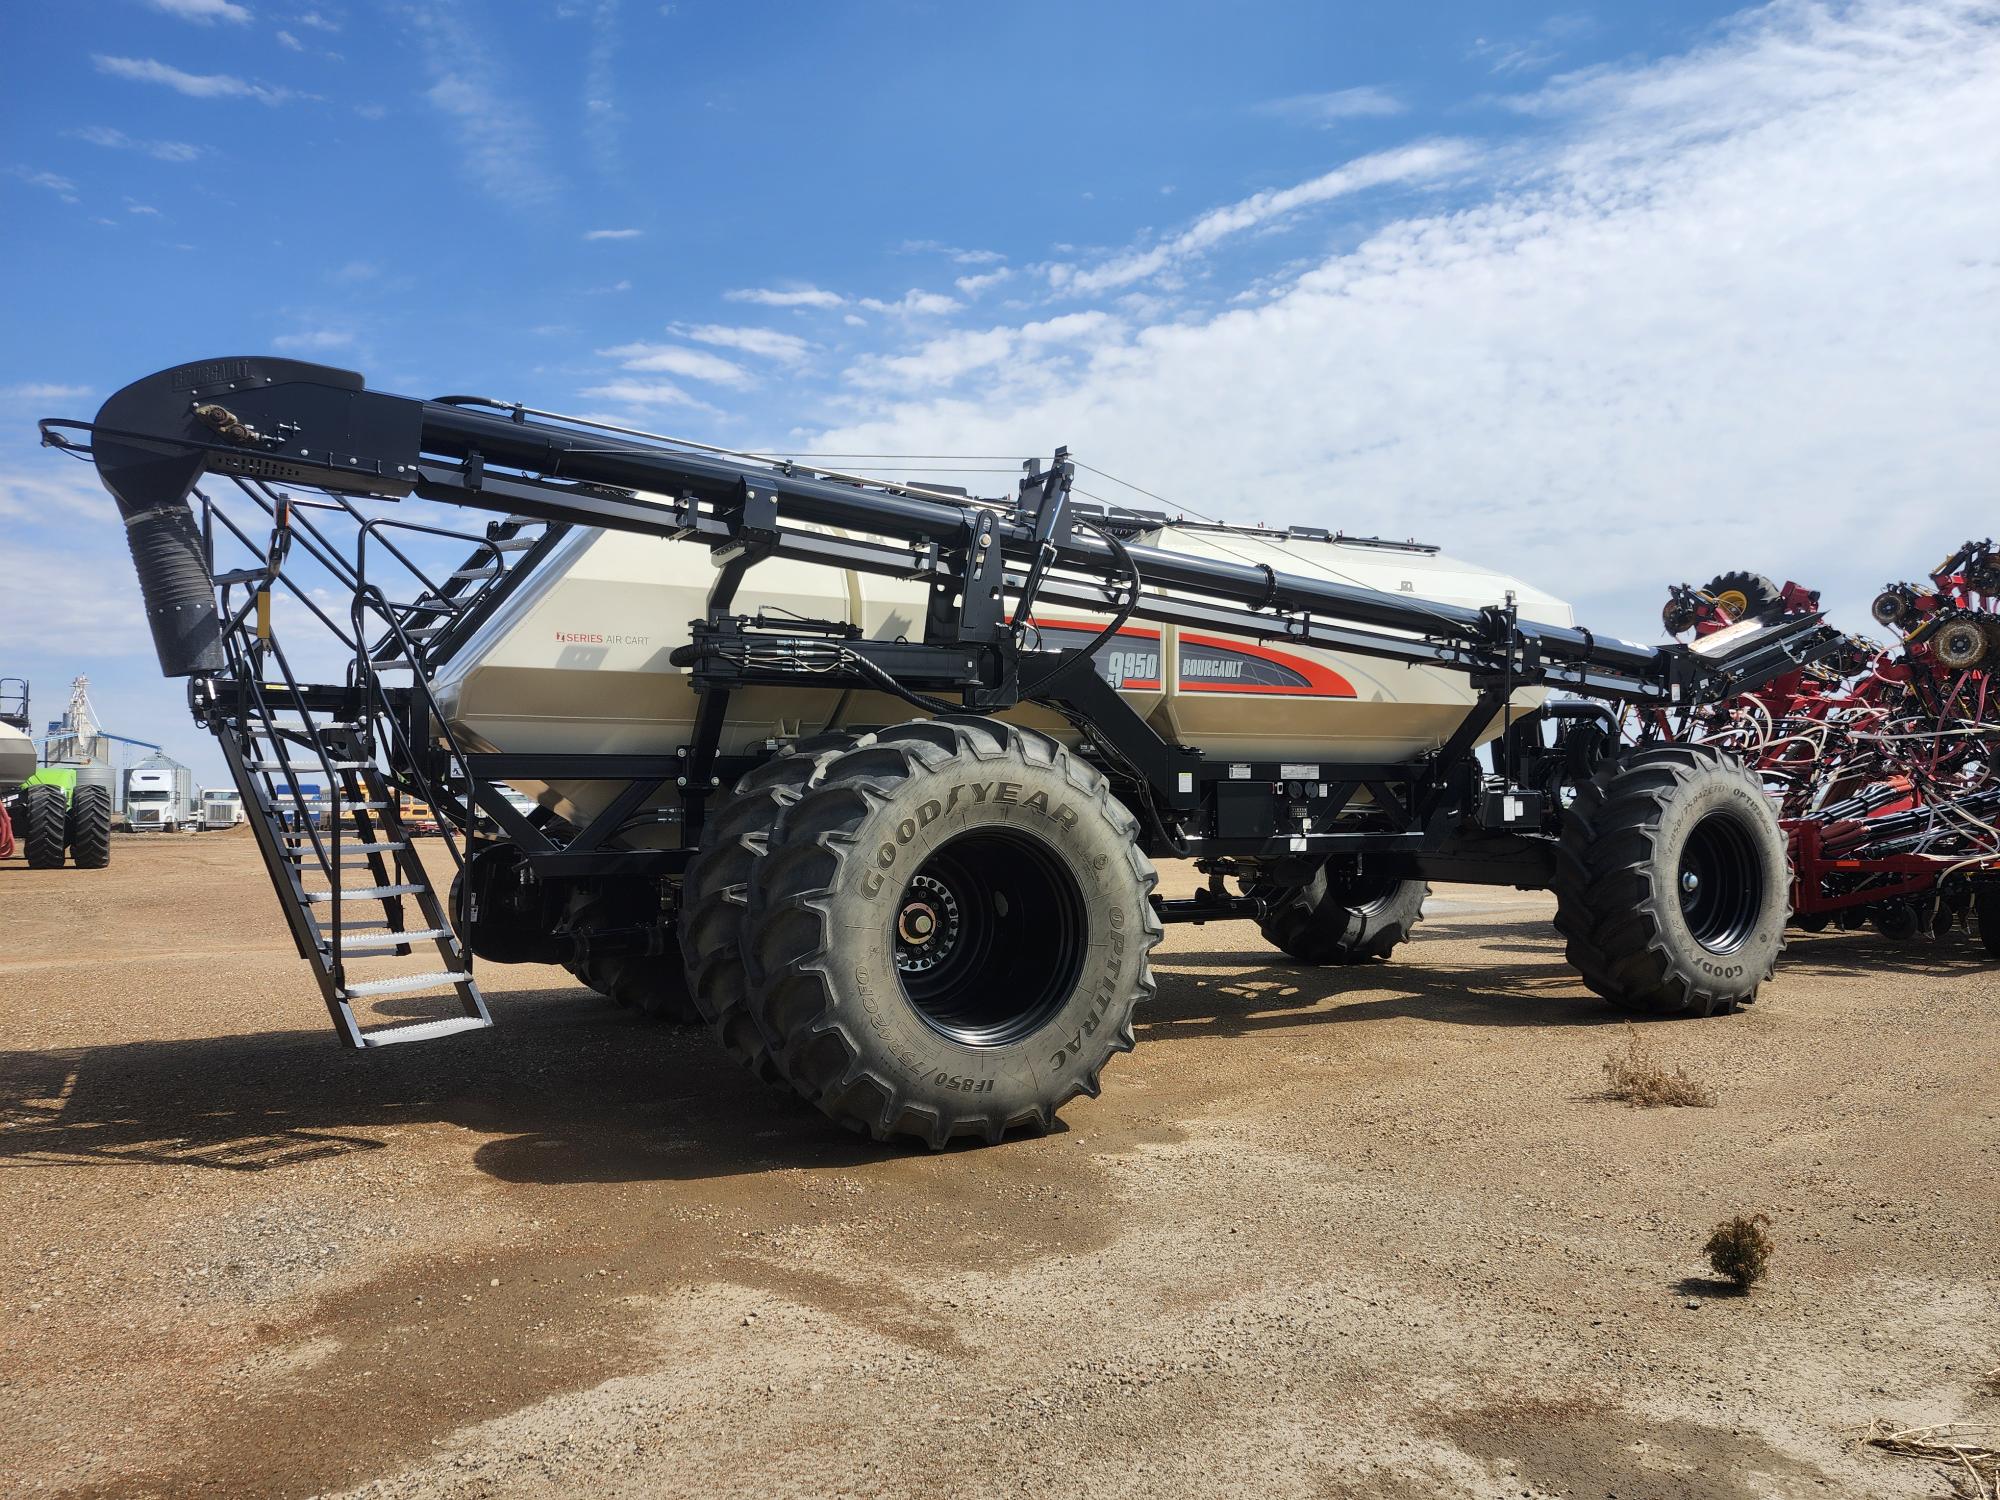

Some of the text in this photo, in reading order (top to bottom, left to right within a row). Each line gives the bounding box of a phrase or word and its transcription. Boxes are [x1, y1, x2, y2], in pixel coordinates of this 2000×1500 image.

[566, 633, 603, 643] SERIES
[606, 635, 622, 644] AIR
[625, 636, 649, 645] CART
[1107, 652, 1158, 689] 9950
[1182, 659, 1243, 678] BOURGAULT
[1050, 906, 1124, 1071] OPTITRAC
